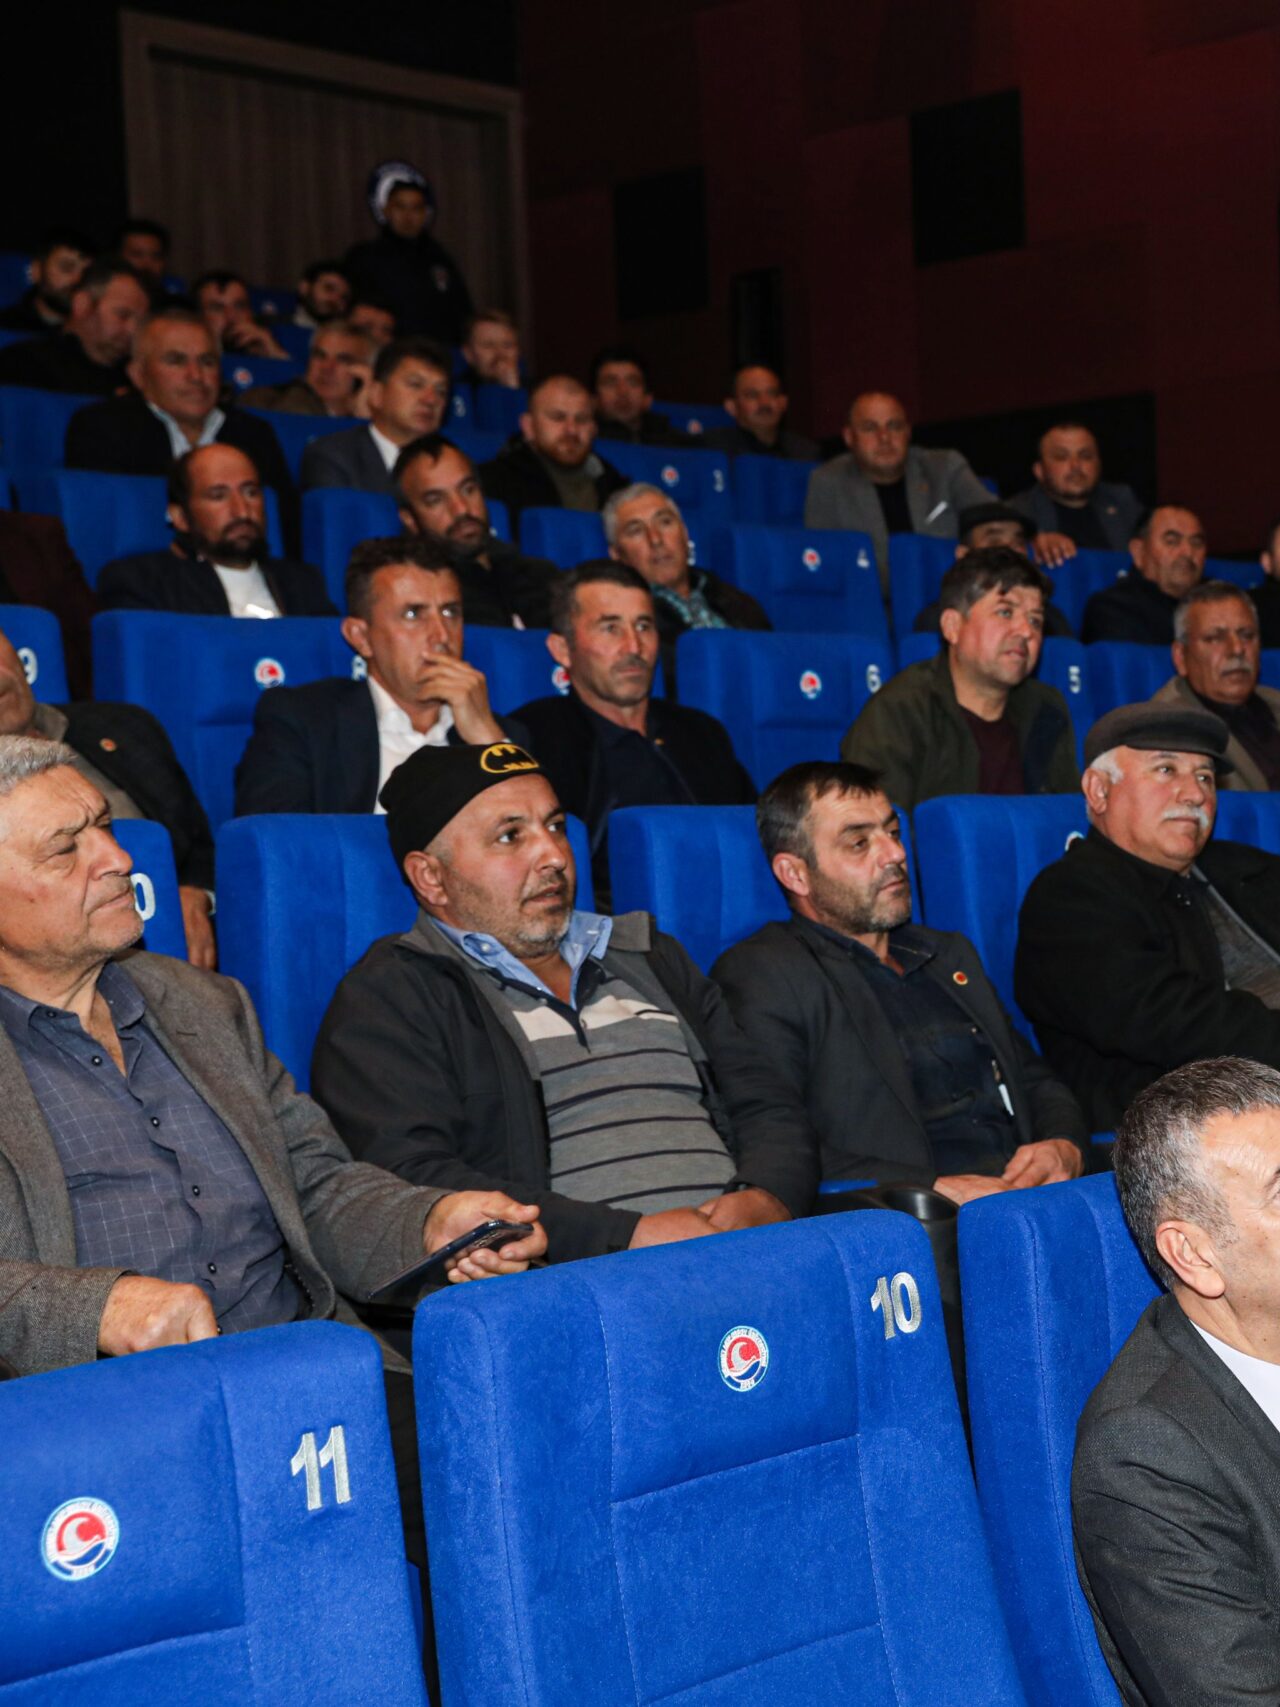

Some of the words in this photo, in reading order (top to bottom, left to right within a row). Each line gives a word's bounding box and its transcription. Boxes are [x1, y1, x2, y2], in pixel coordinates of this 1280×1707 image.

[866, 664, 882, 693] 6
[871, 1272, 922, 1340] 10
[291, 1425, 351, 1511] 11
